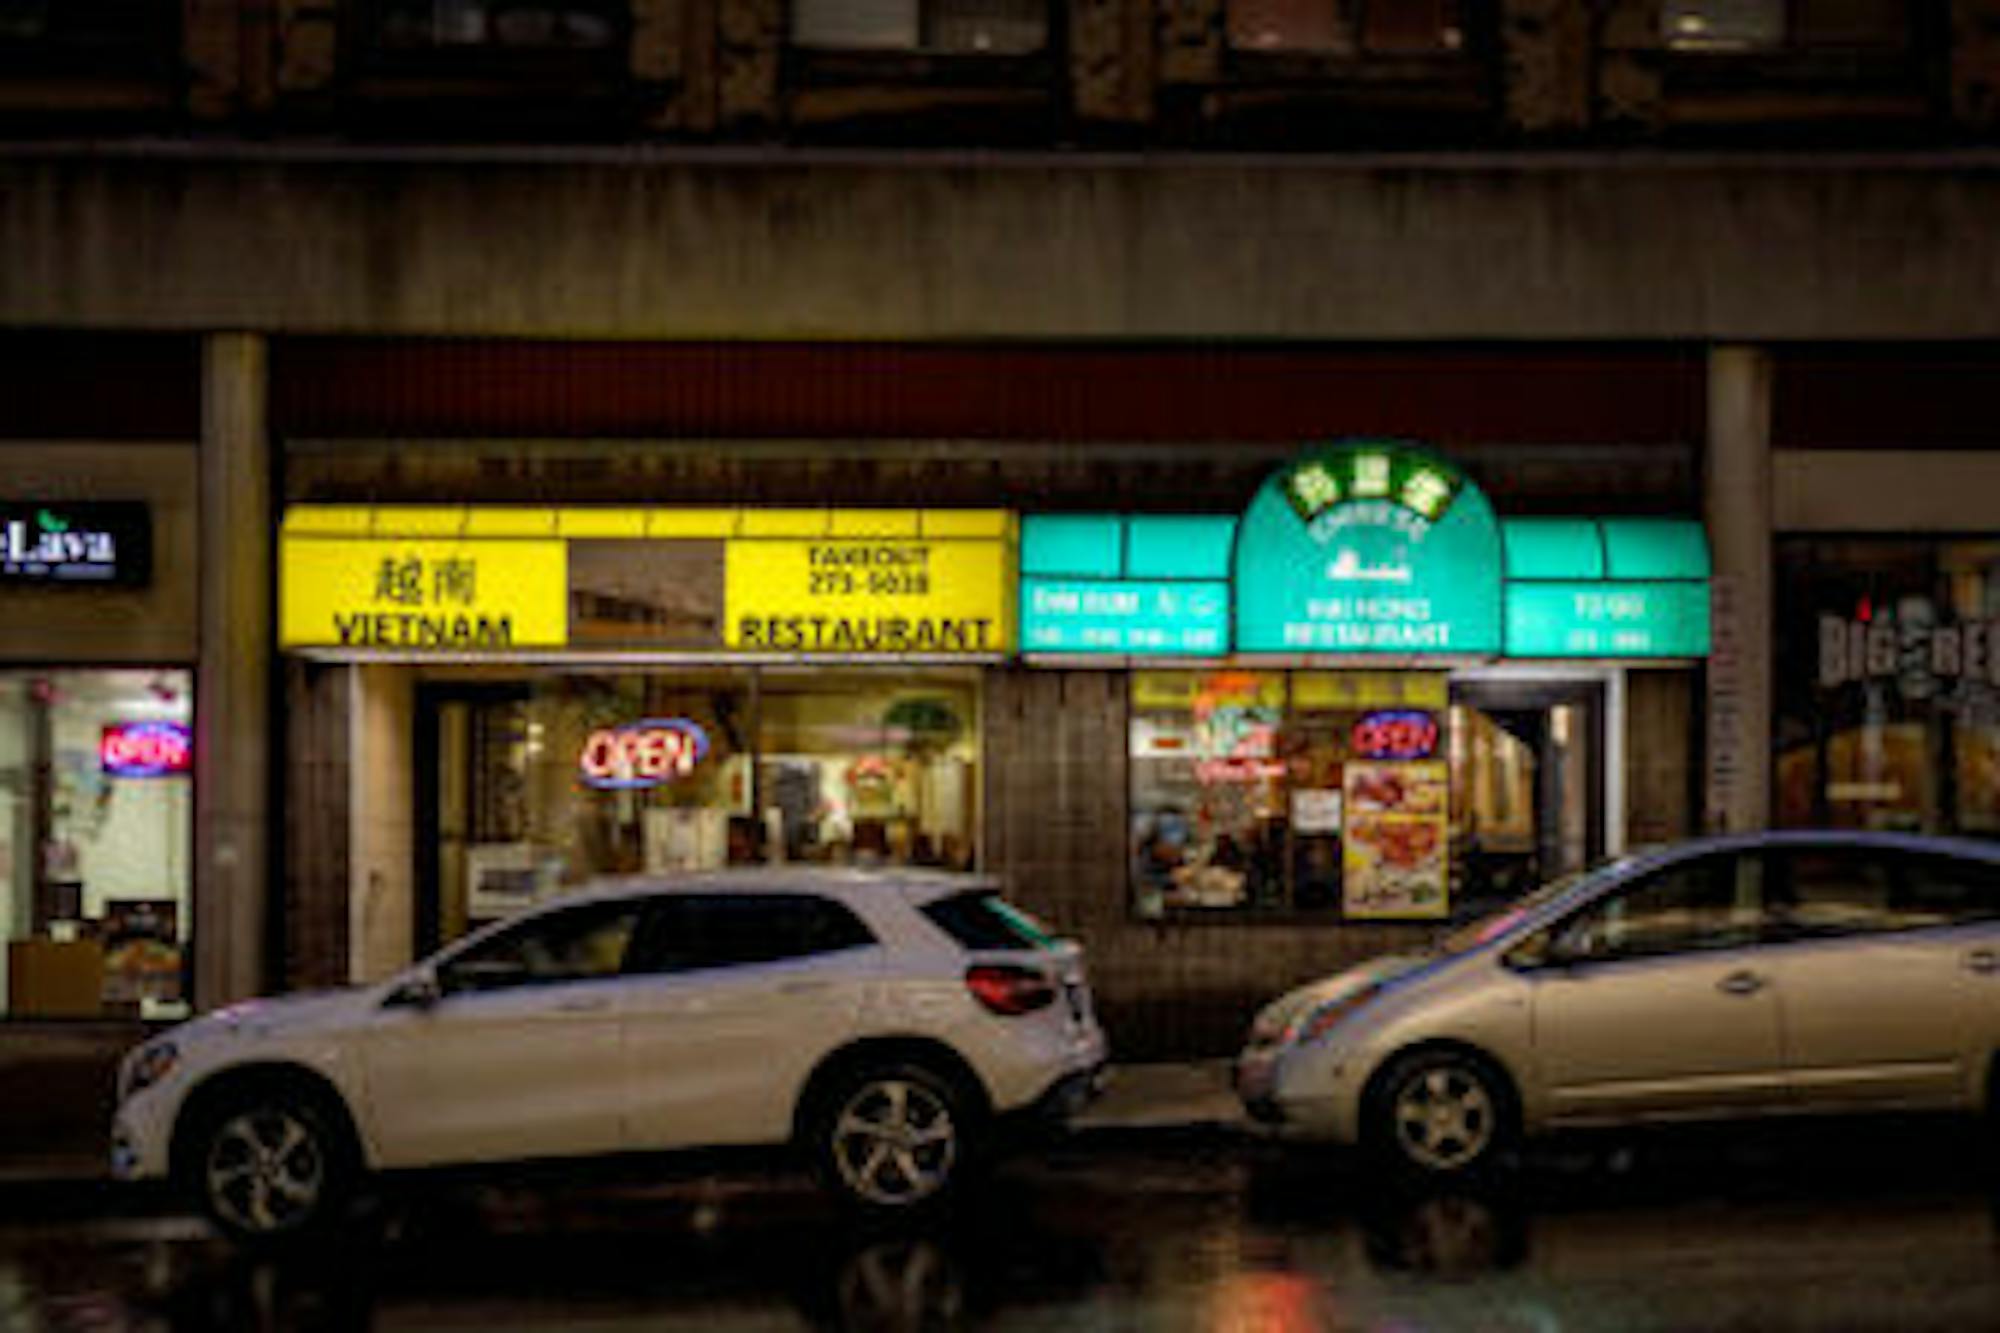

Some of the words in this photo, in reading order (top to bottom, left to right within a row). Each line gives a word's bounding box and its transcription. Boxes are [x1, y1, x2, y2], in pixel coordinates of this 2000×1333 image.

[333, 612, 513, 646] VIETNAM
[740, 617, 992, 649] RESTAURANT
[1351, 719, 1439, 752] OPEN
[580, 728, 694, 780] OPEN
